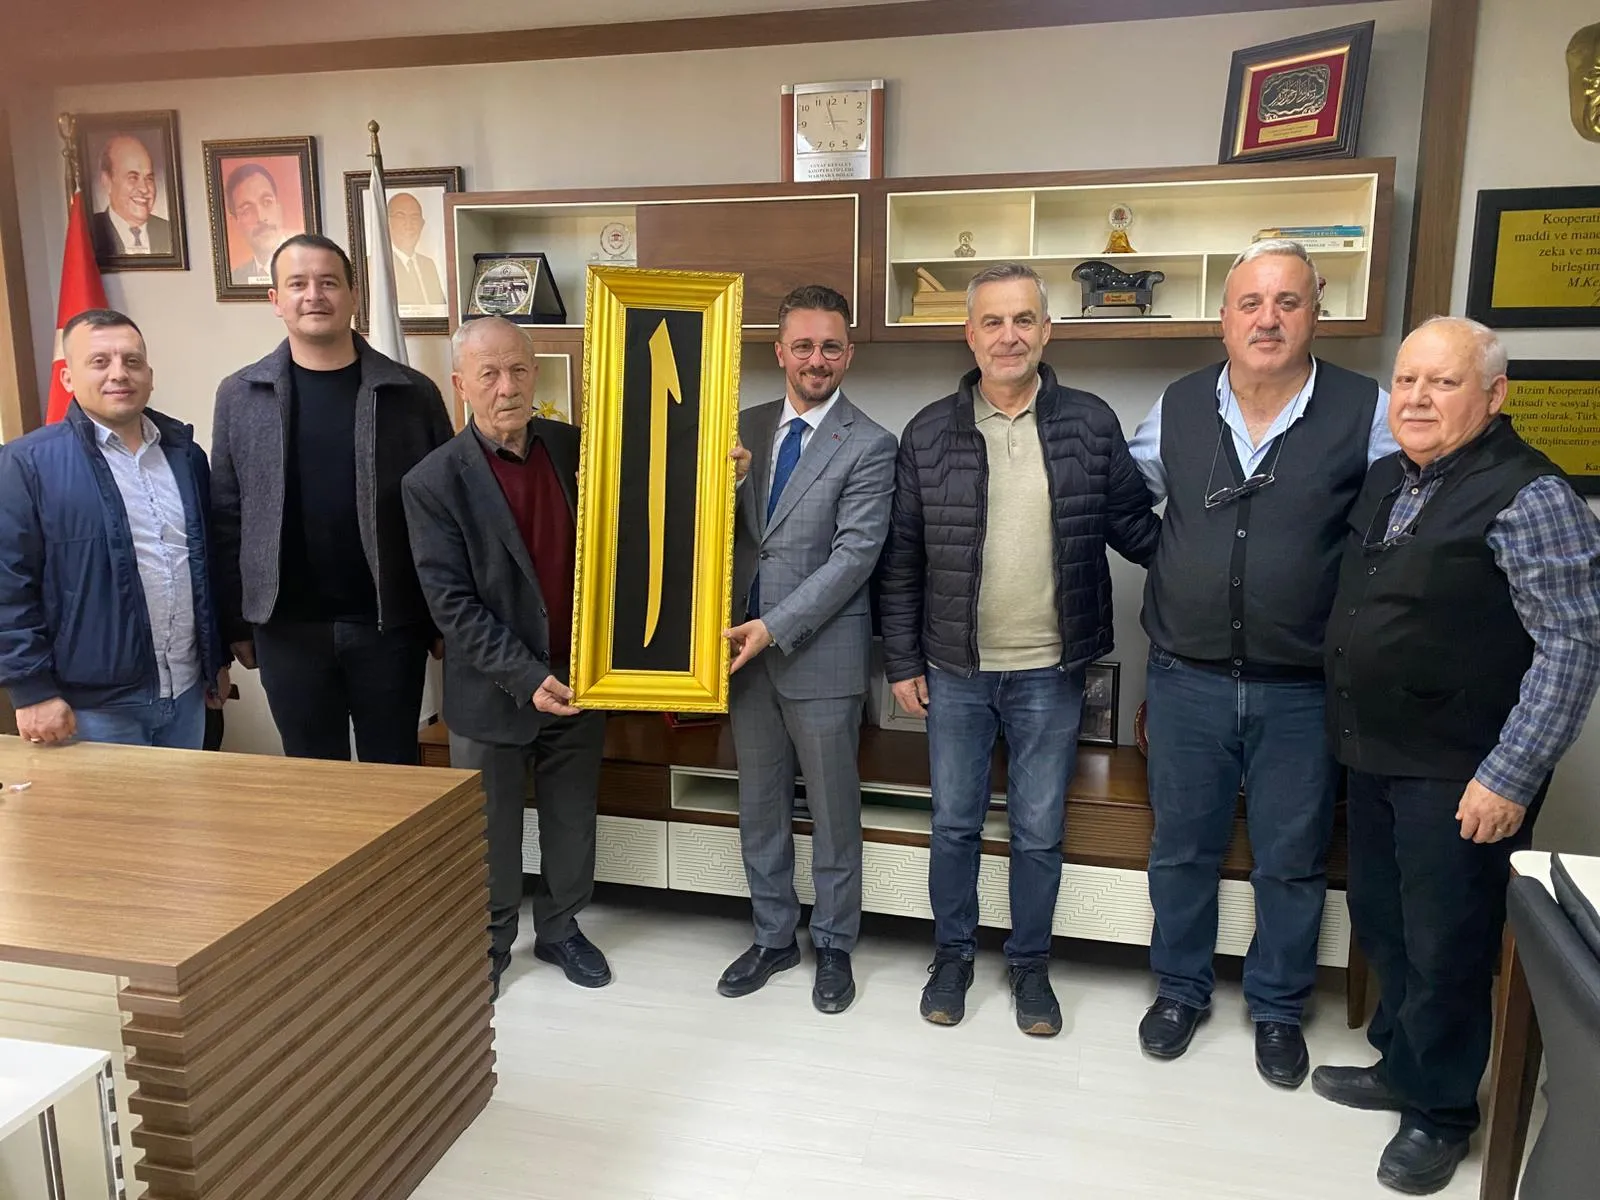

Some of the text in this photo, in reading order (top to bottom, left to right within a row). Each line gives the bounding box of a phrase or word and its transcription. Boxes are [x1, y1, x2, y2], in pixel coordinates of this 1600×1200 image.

[828, 98, 837, 106] 12
[800, 104, 810, 112] 10
[857, 118, 863, 126] 3
[817, 141, 823, 149] 7
[829, 140, 835, 148] 6
[842, 140, 848, 148] 5
[1514, 231, 1550, 242] maddi
[1554, 232, 1568, 240] ve
[1538, 246, 1565, 257] zeka
[1569, 248, 1583, 256] ve
[1516, 385, 1545, 395] Bizim
[1509, 398, 1543, 407] iktisadi
[1560, 399, 1589, 409] sosyal
[1575, 411, 1598, 420] Türk
